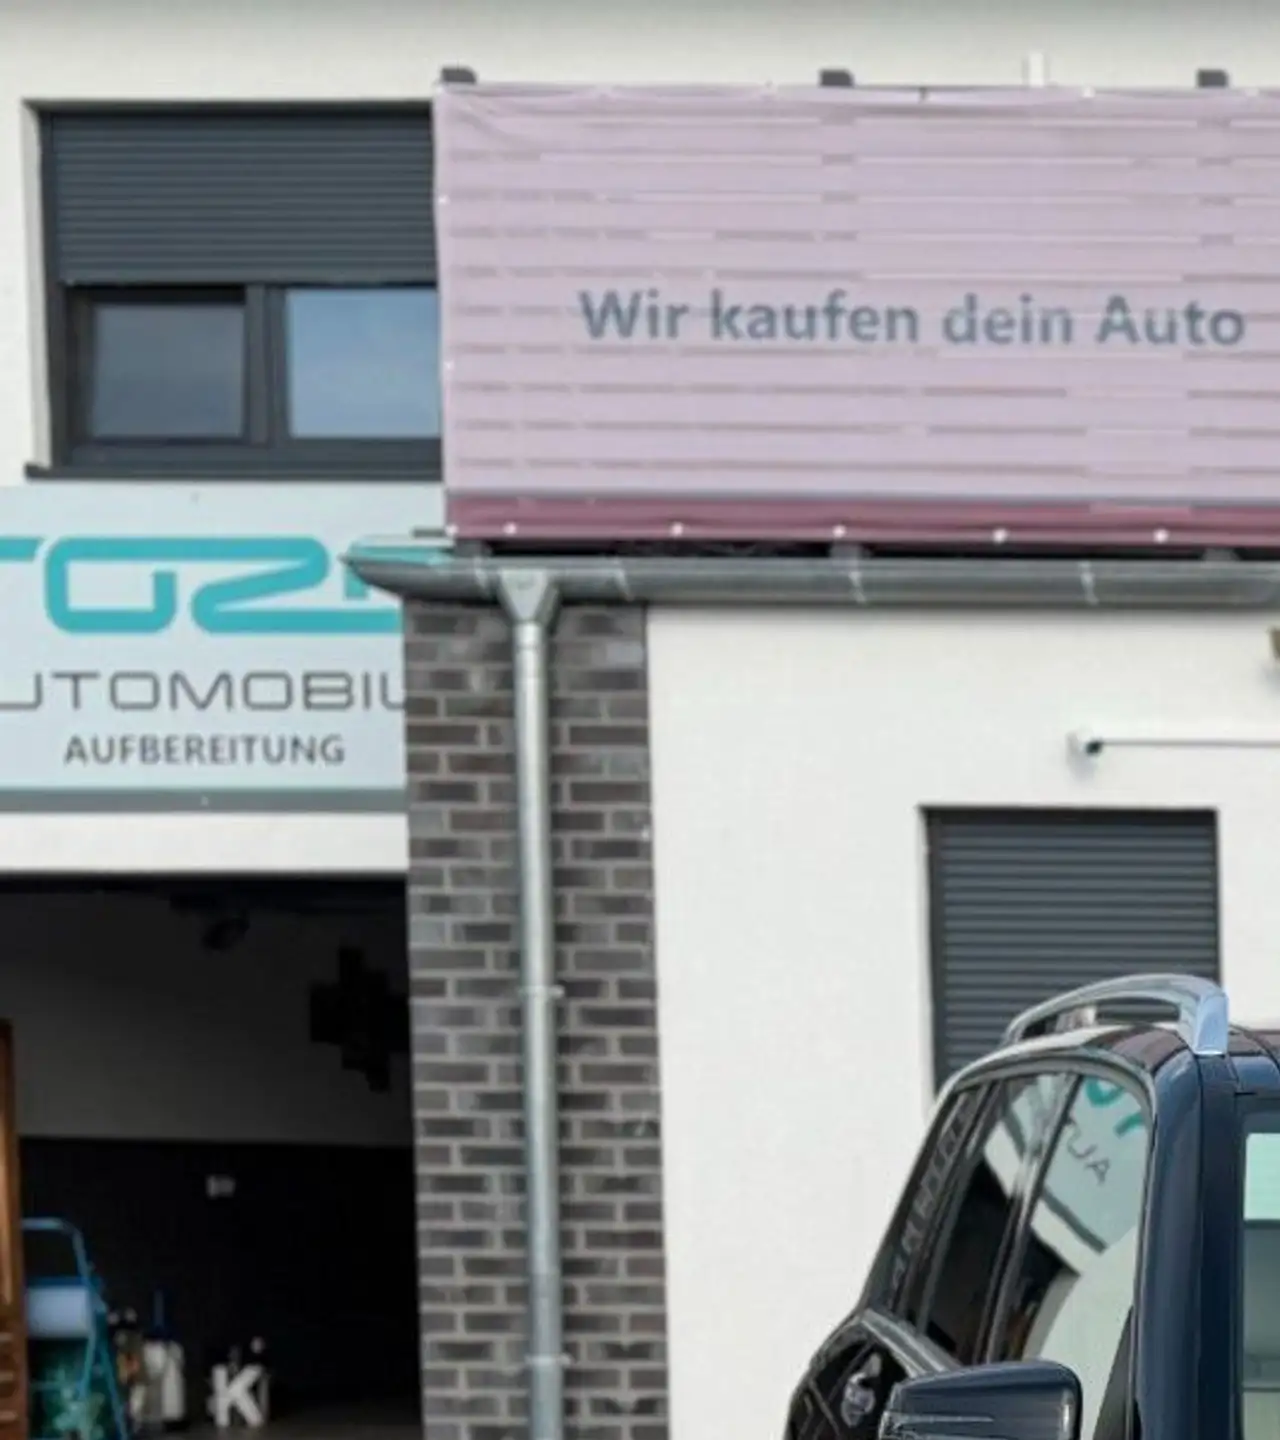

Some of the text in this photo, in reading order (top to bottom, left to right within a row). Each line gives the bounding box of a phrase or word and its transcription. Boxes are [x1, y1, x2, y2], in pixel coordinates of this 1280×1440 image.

[578, 289, 1247, 348] Wir kaufen dein Auto
[0, 670, 407, 712] UTOMOBIL
[64, 734, 346, 765] AUFBEREITUNG
